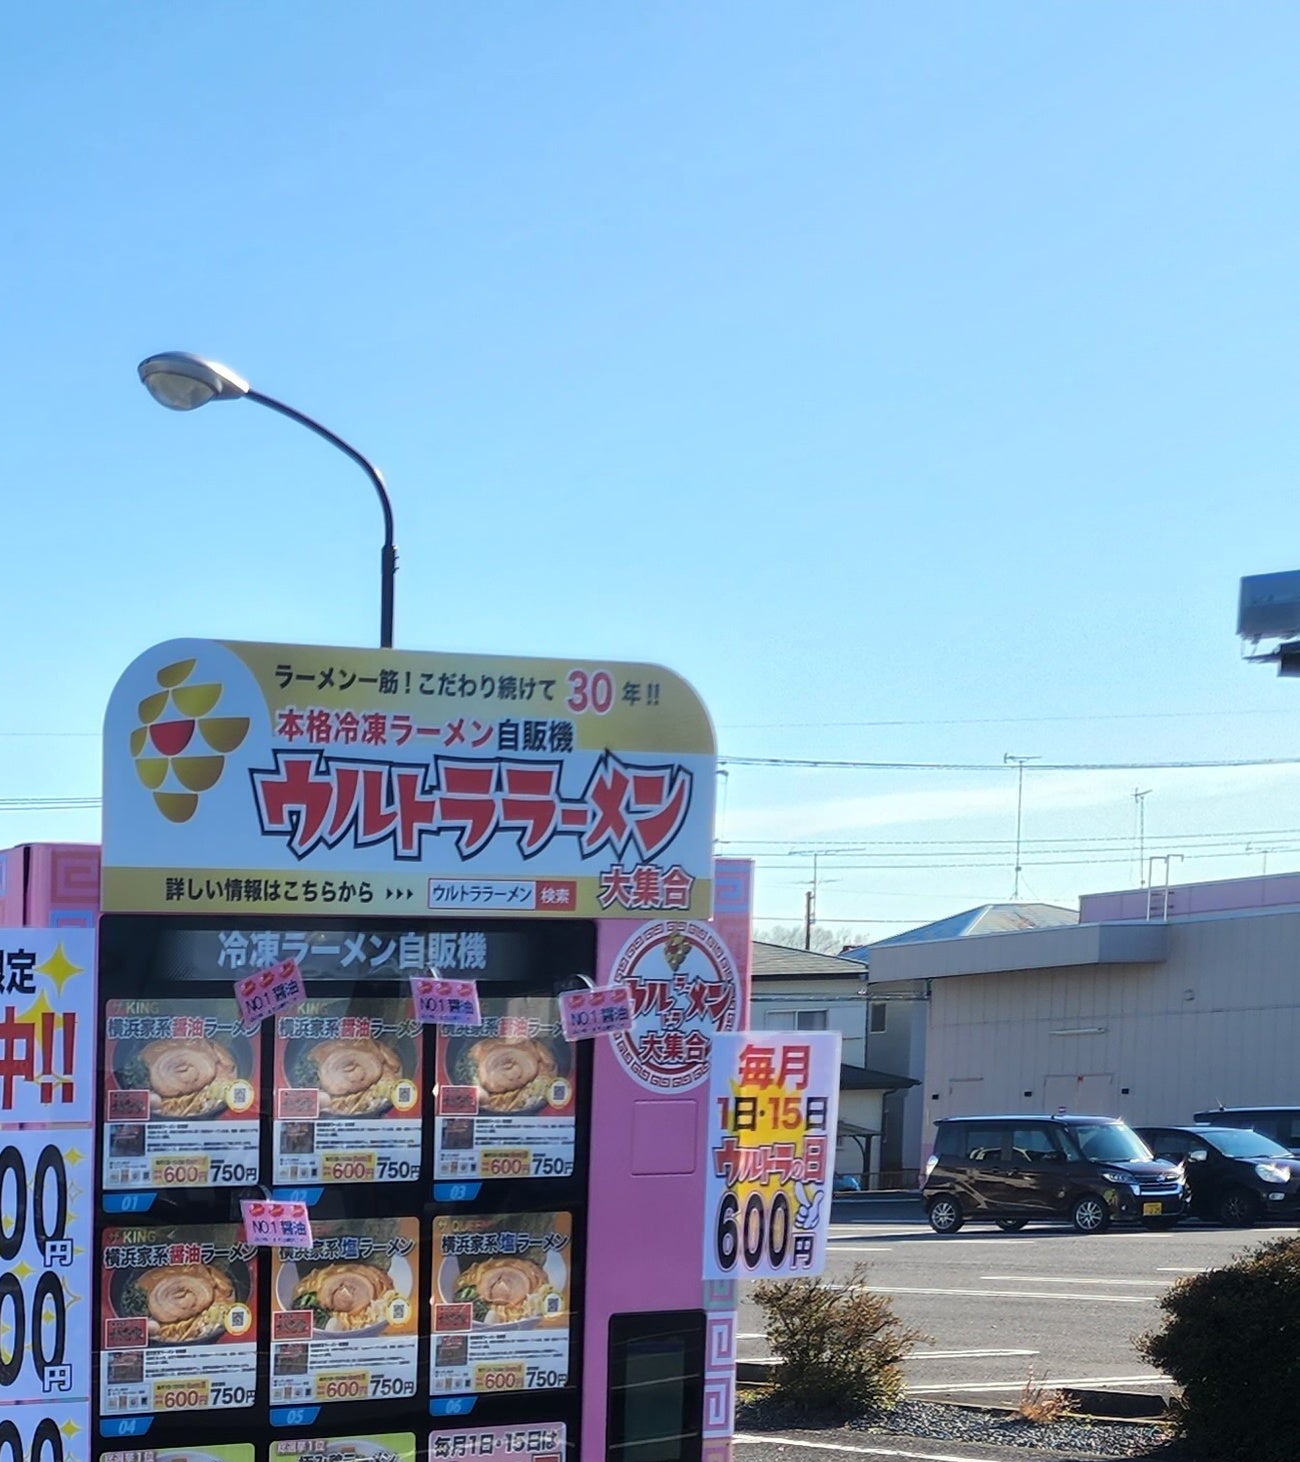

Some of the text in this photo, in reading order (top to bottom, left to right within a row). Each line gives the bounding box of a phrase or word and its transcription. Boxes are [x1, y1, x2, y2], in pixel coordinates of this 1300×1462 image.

[276, 708, 574, 754] 本格冷凍ラーメン自販機
[248, 749, 694, 863] ウルトララーメン
[165, 877, 374, 903] 詳しい情報はこちらから
[432, 884, 571, 906] ウルトララーメン 検索
[598, 864, 696, 911] 大集合
[217, 931, 488, 970] 冷凍ラーメン自販機
[639, 1030, 711, 1065] 大集合
[738, 1043, 811, 1090] 毎月
[210, 1164, 257, 1183] 750円
[377, 1161, 421, 1180] 750円
[532, 1157, 574, 1175] 750円
[712, 1135, 828, 1188] ウルトラの日
[122, 1230, 157, 1244] KING
[715, 1190, 816, 1272] 600円
[441, 1233, 570, 1257] 横浜家系塩ラーメン
[370, 1378, 414, 1395] 750円
[526, 1370, 568, 1388] 750円
[211, 1387, 256, 1405] 750円
